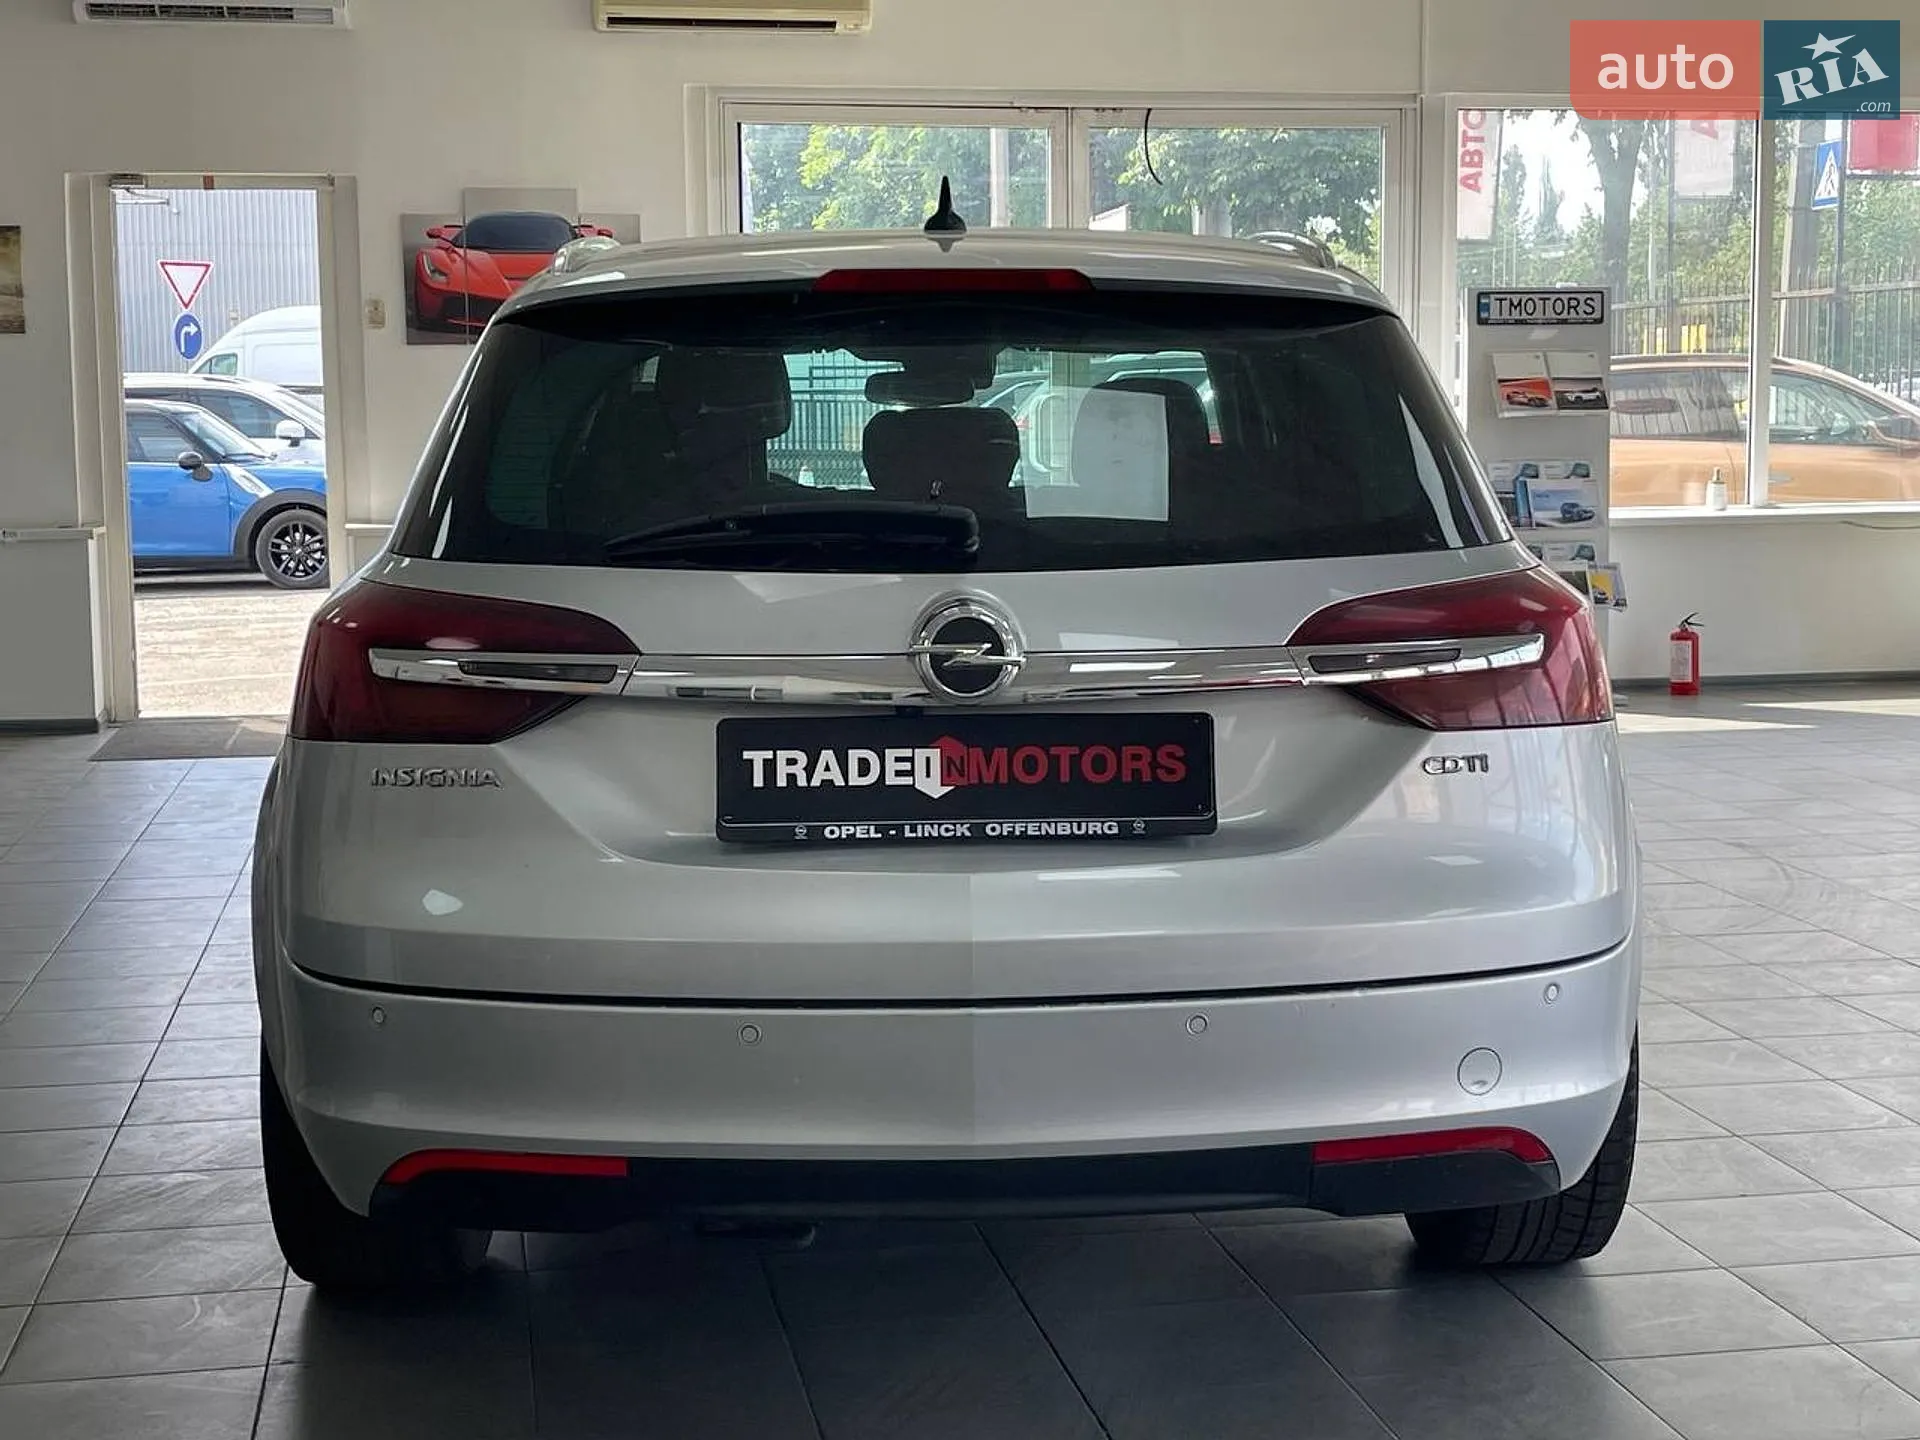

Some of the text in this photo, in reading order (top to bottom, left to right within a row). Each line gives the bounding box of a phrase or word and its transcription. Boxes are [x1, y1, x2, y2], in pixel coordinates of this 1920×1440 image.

[1494, 297, 1596, 316] TMOTORS
[743, 749, 913, 787] TRADE
[968, 744, 1187, 786] MOTORS
[1422, 754, 1489, 775] CDTI
[371, 767, 502, 788] INSIGNIA
[824, 825, 882, 839] OPEL
[904, 823, 971, 838] LINCK
[985, 821, 1119, 836] OFFENBURG
